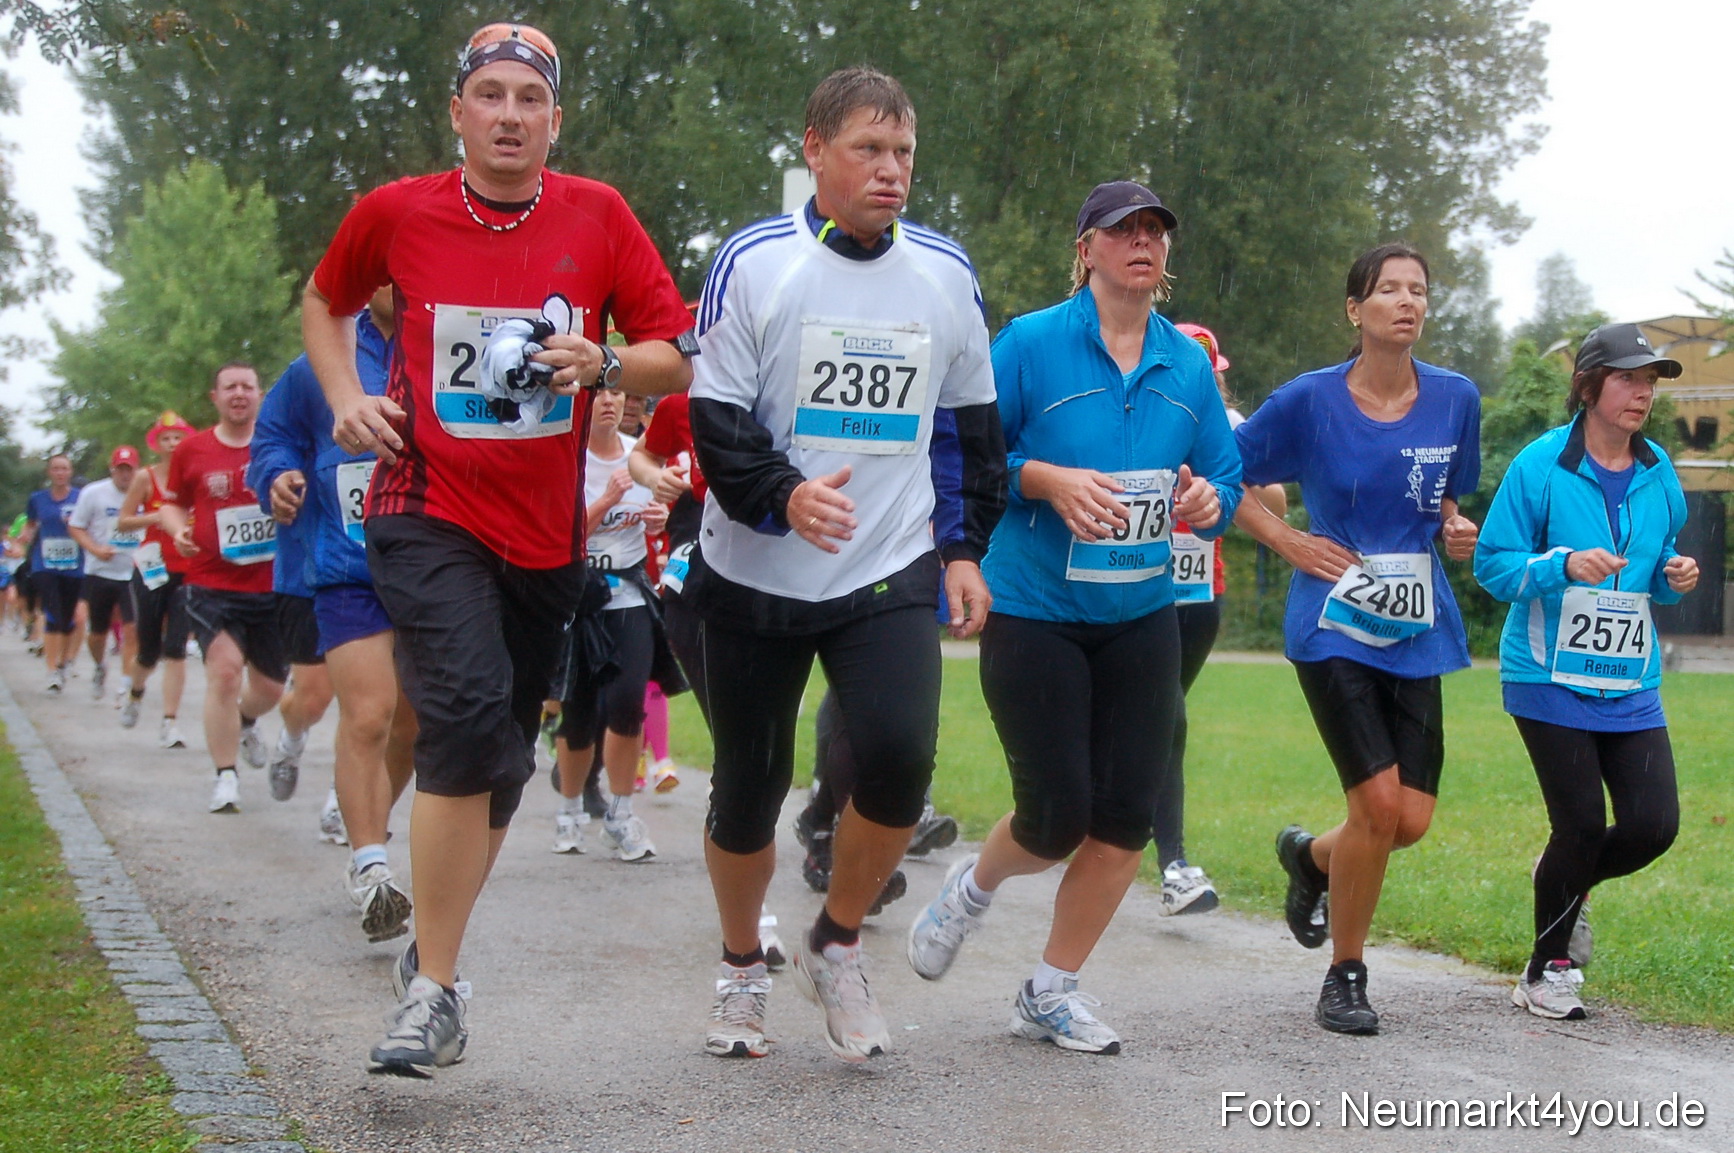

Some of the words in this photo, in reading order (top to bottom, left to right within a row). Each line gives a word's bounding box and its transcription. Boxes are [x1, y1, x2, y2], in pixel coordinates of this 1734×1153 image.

[843, 337, 893, 351] BOCK
[810, 360, 918, 409] 2387
[841, 417, 882, 436] Felix
[1400, 448, 1415, 457] 12.
[226, 518, 275, 544] 2882
[1108, 550, 1145, 569] Sonja
[1343, 573, 1425, 619] 2480
[1568, 613, 1645, 654] 2574
[1584, 658, 1628, 676] Renate
